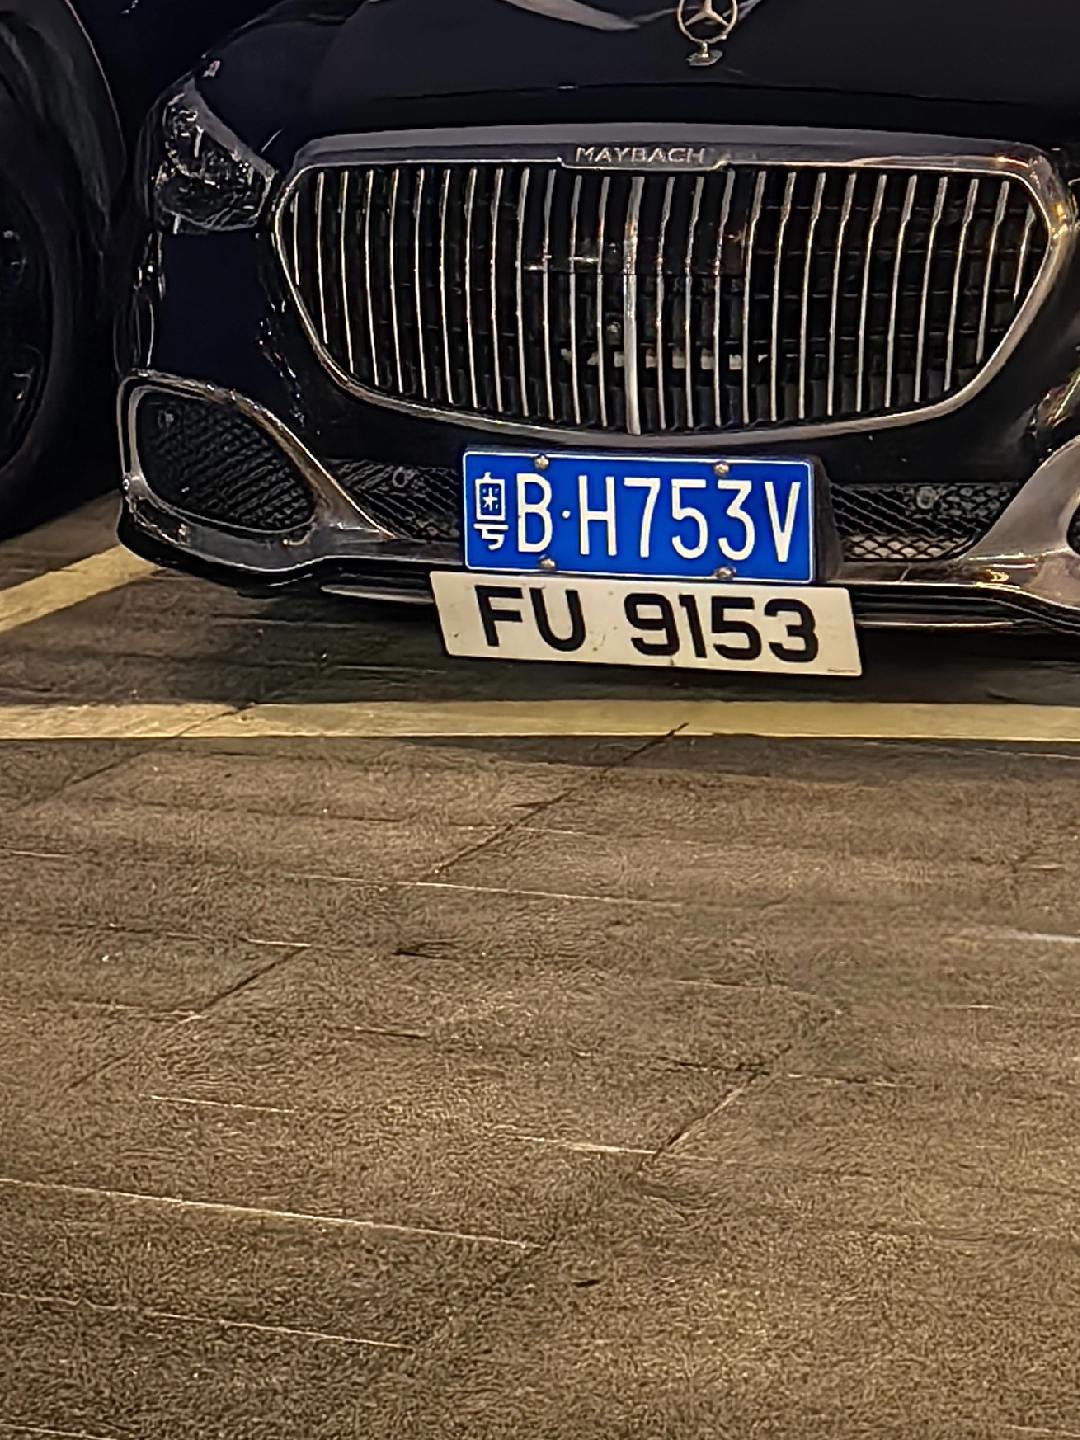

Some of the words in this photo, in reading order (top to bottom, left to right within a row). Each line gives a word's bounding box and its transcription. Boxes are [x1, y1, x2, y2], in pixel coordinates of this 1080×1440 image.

[575, 147, 705, 163] MAYBACH
[474, 584, 587, 653] FU
[623, 592, 820, 663] 9153
